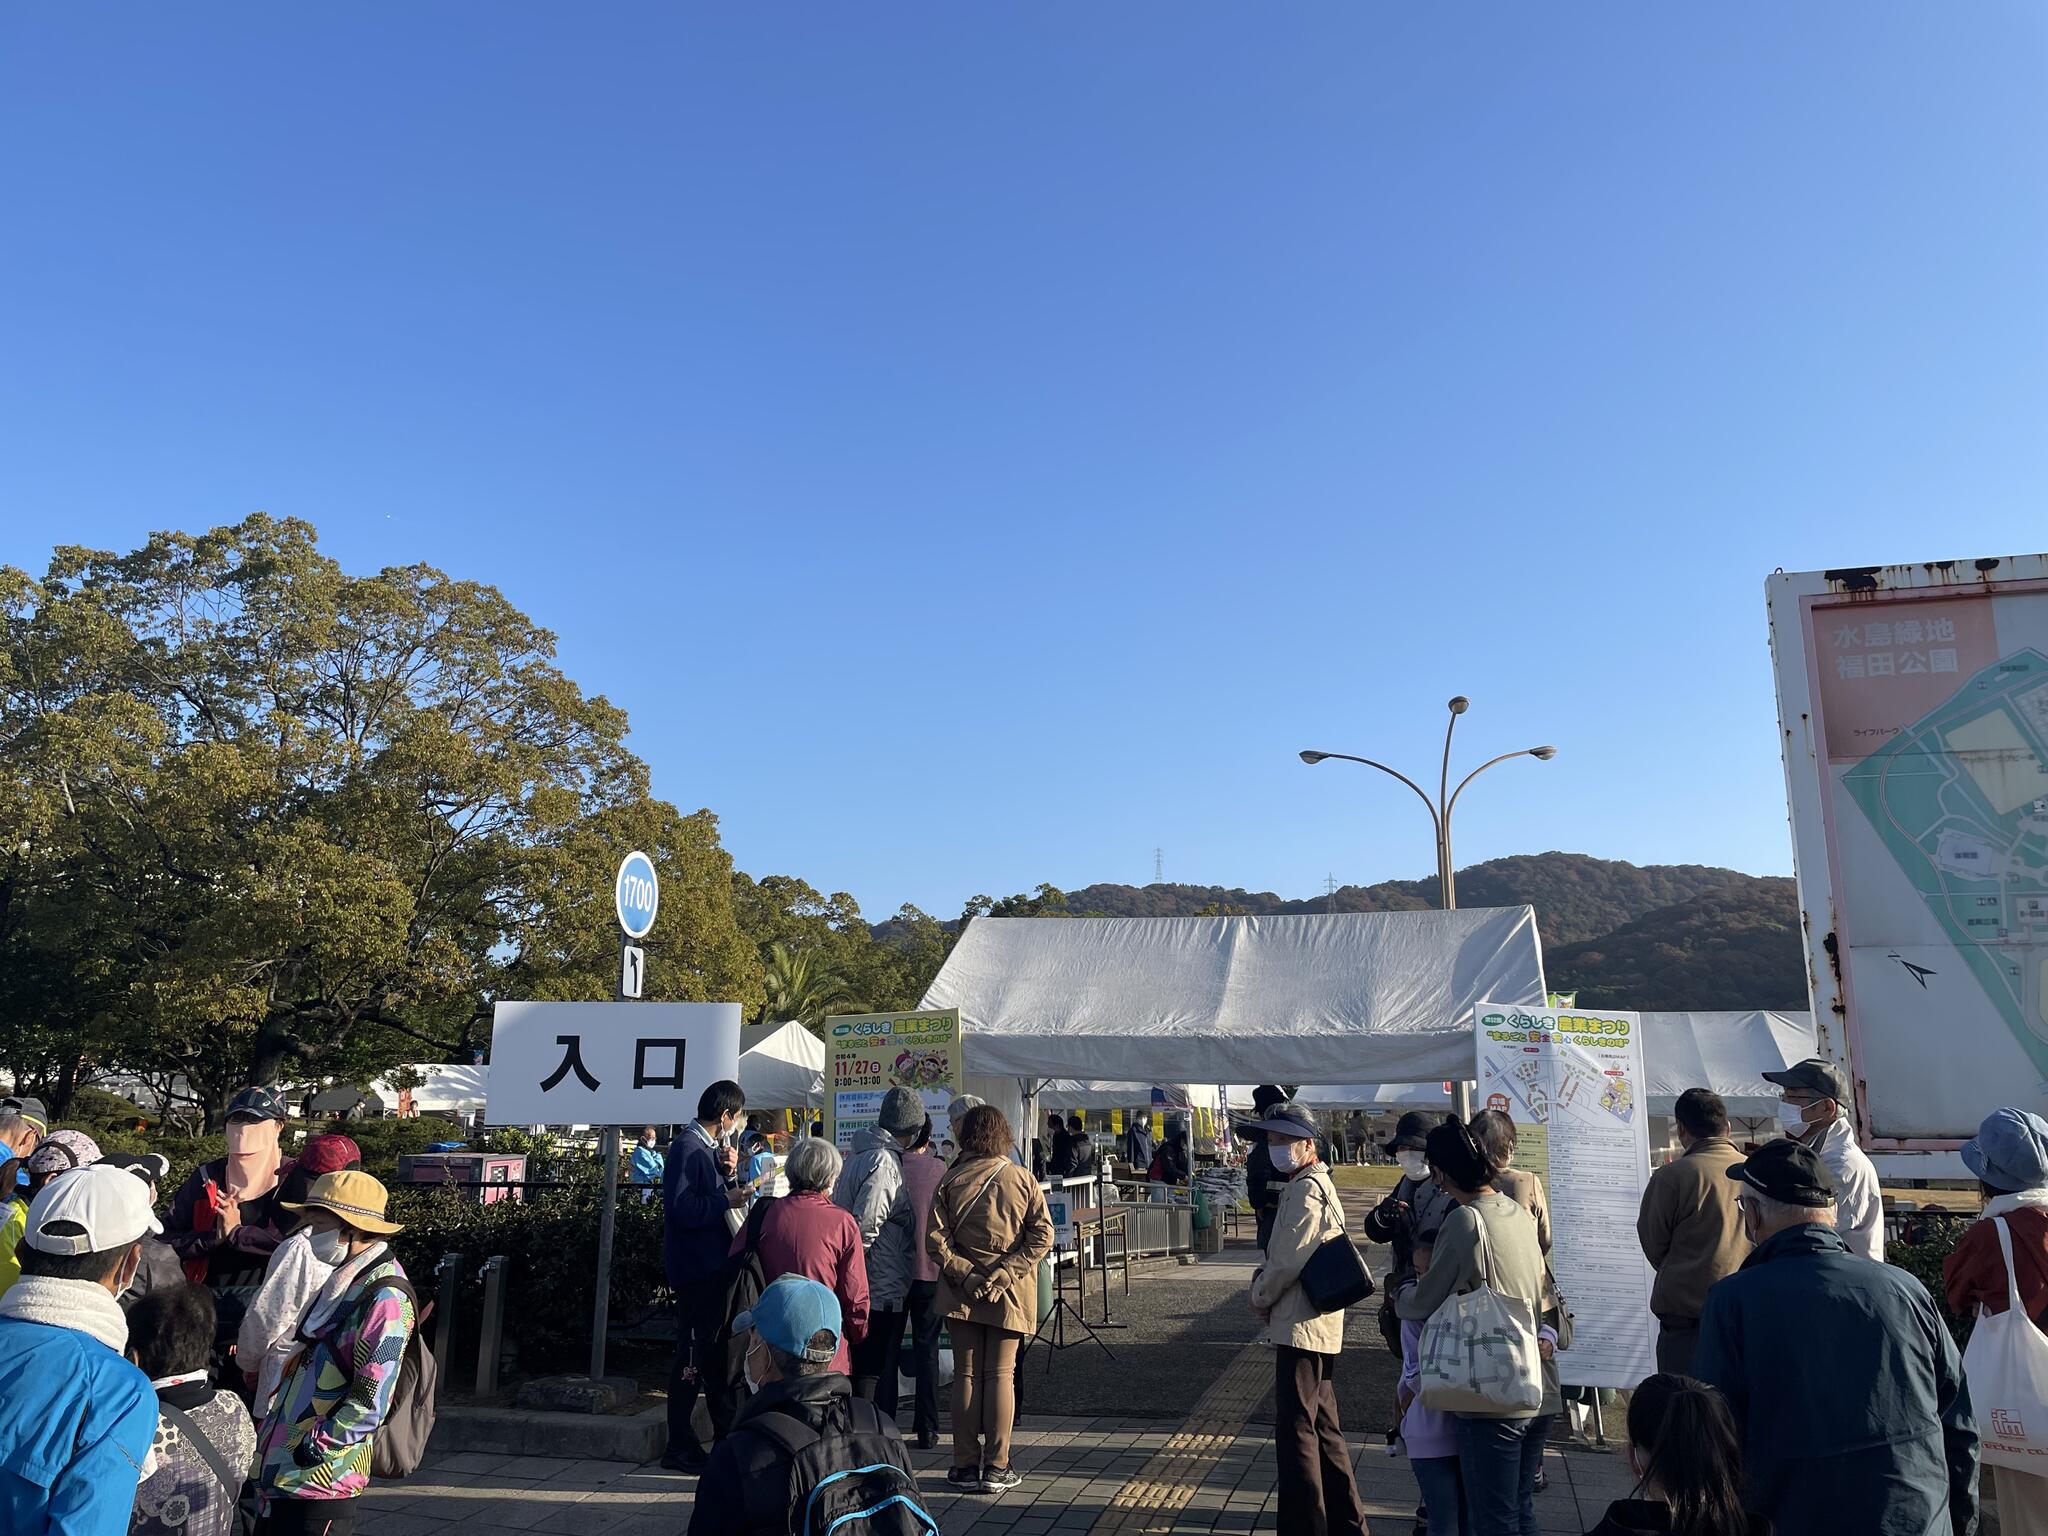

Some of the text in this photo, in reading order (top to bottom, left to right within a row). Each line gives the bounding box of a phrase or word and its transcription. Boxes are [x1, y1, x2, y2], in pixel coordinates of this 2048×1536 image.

[1833, 617, 1956, 649] 水島緑地
[1836, 648, 1959, 680] 福田公園
[623, 875, 653, 913] 1700
[853, 1021, 892, 1036] くらしき
[1507, 1014, 1555, 1030] くらしき
[1558, 1016, 1629, 1034] 農業まつり
[539, 1034, 687, 1094] 入口
[835, 1060, 869, 1076] 11/27
